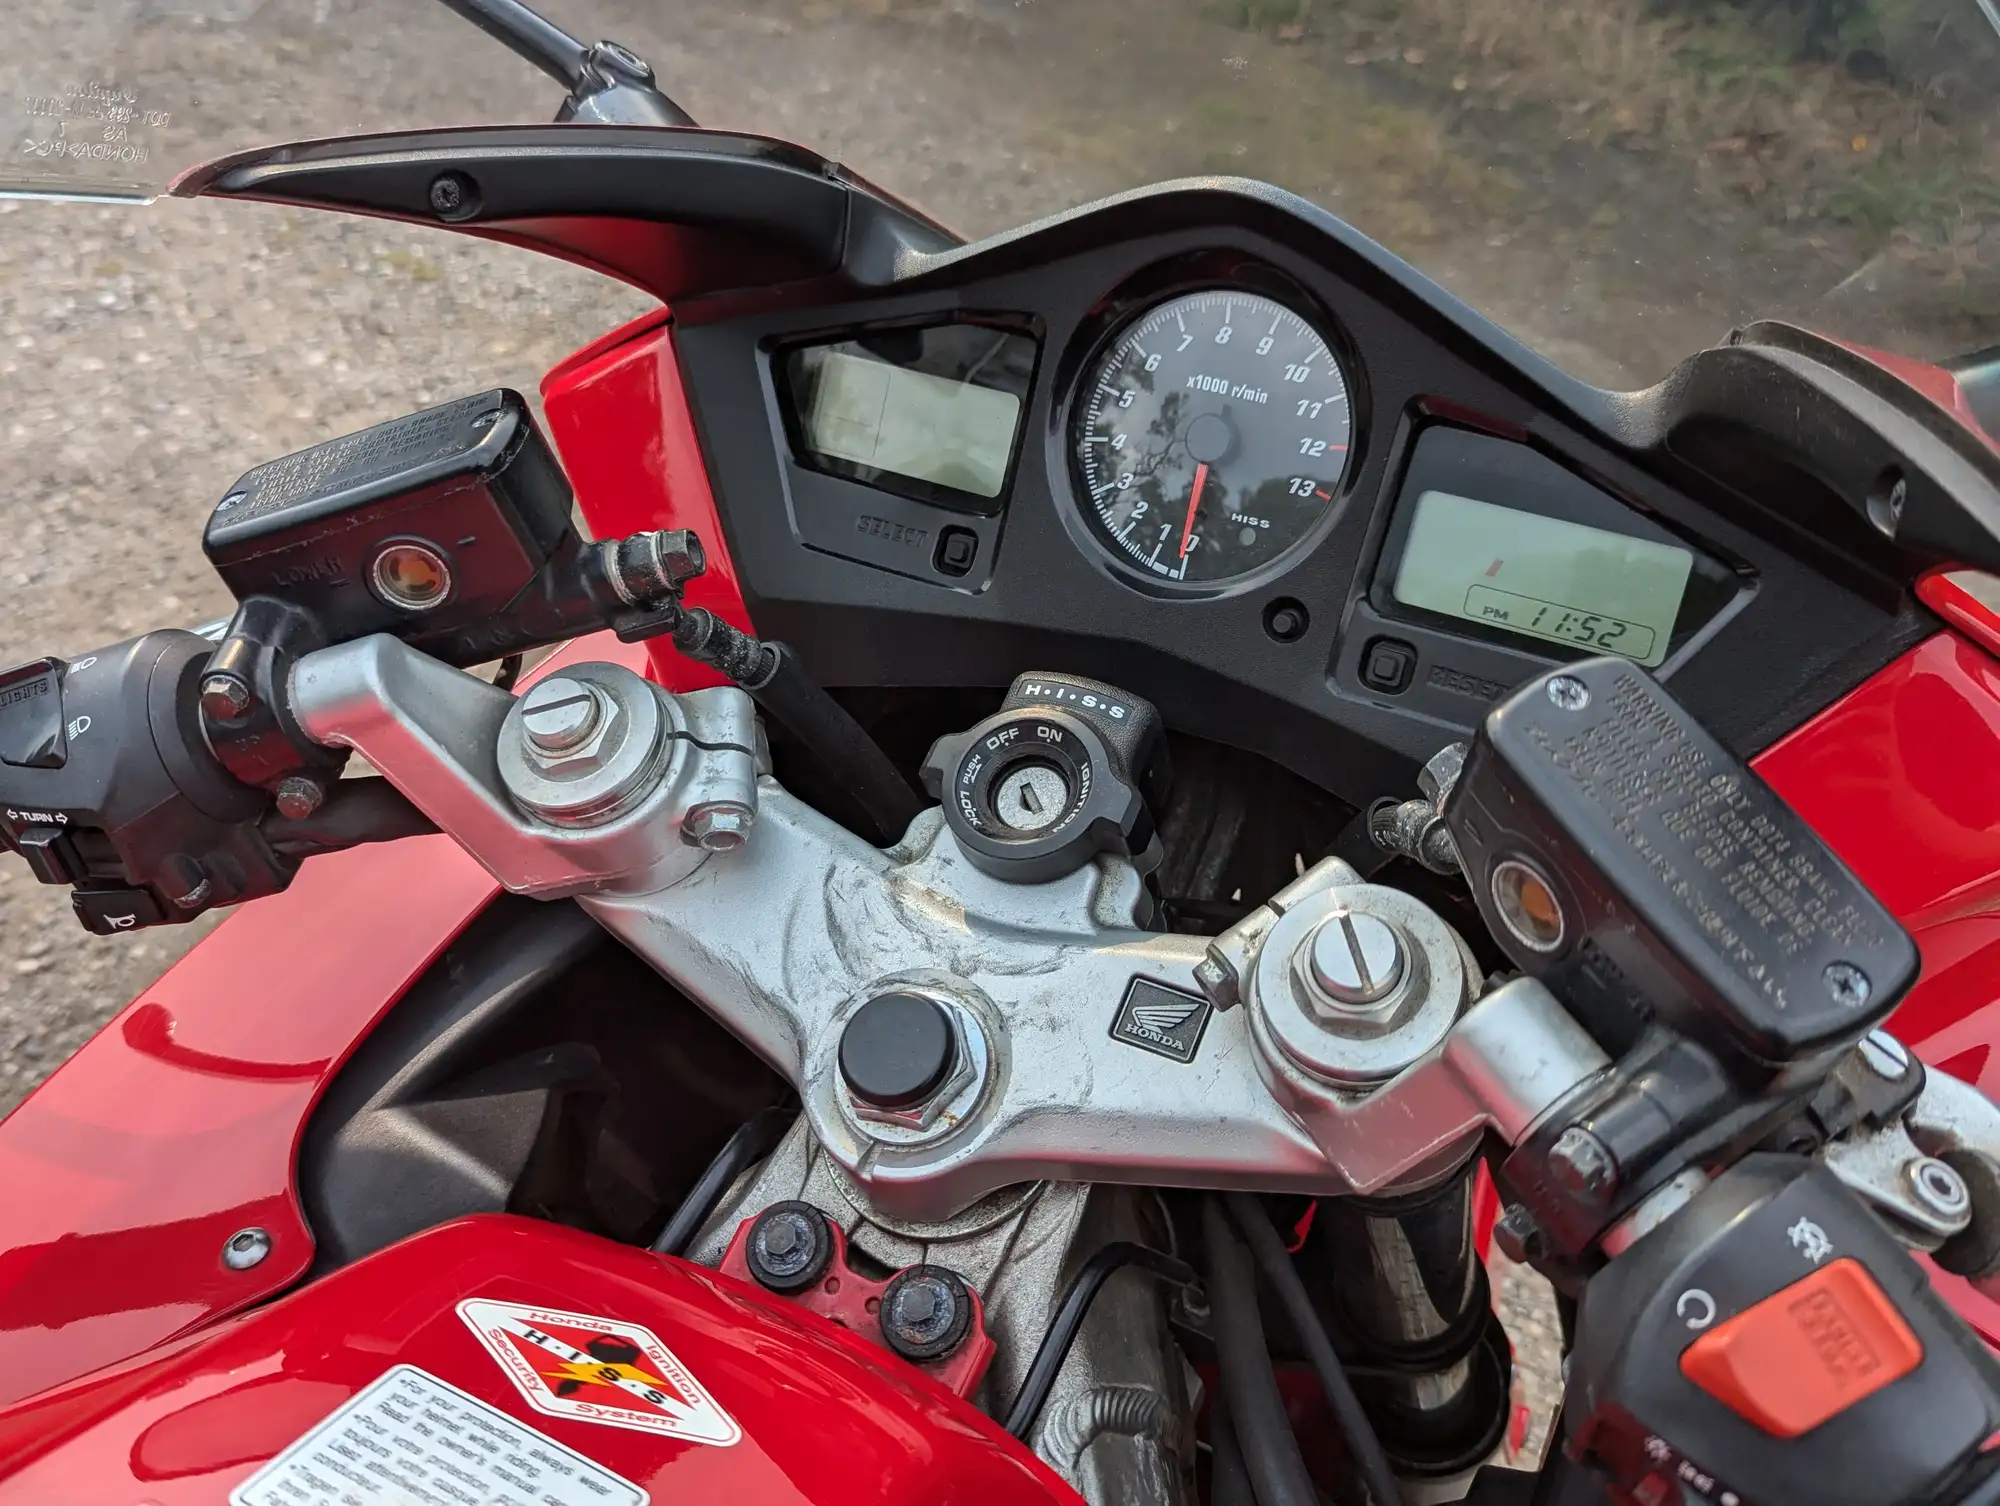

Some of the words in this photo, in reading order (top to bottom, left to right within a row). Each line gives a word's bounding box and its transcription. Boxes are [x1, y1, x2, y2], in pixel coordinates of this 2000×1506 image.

[1177, 335, 1193, 352] 7
[1215, 327, 1232, 345] 8
[1256, 336, 1275, 356] 9
[1145, 354, 1162, 372] 6
[1284, 363, 1311, 384] 10
[1119, 391, 1136, 408] 5
[1187, 374, 1228, 395] x1000
[1231, 385, 1268, 405] r/min
[1297, 399, 1322, 419] 11
[1111, 434, 1128, 450] 4
[1300, 437, 1327, 457] 12
[1117, 472, 1134, 490] 3
[1289, 477, 1317, 498] 13
[1131, 501, 1149, 519] 2
[857, 515, 928, 547] SELECT
[1231, 513, 1271, 529] HISS
[1160, 523, 1172, 541] 1
[1183, 534, 1200, 552] 0
[1482, 605, 1509, 622] PM
[1530, 605, 1627, 649] 11:52
[0, 680, 48, 707] LIGHTS
[986, 727, 1020, 751] OFF
[1036, 726, 1063, 743] ON
[962, 754, 982, 785] PUSH
[1052, 762, 1092, 833] IGNITION
[20, 811, 53, 823] TURN
[960, 791, 982, 827] LOCK
[1124, 1023, 1185, 1051] HONDA
[529, 1312, 613, 1332] Honda
[487, 1327, 545, 1393] Security
[646, 1345, 701, 1404] Ignition
[573, 1403, 677, 1429] System
